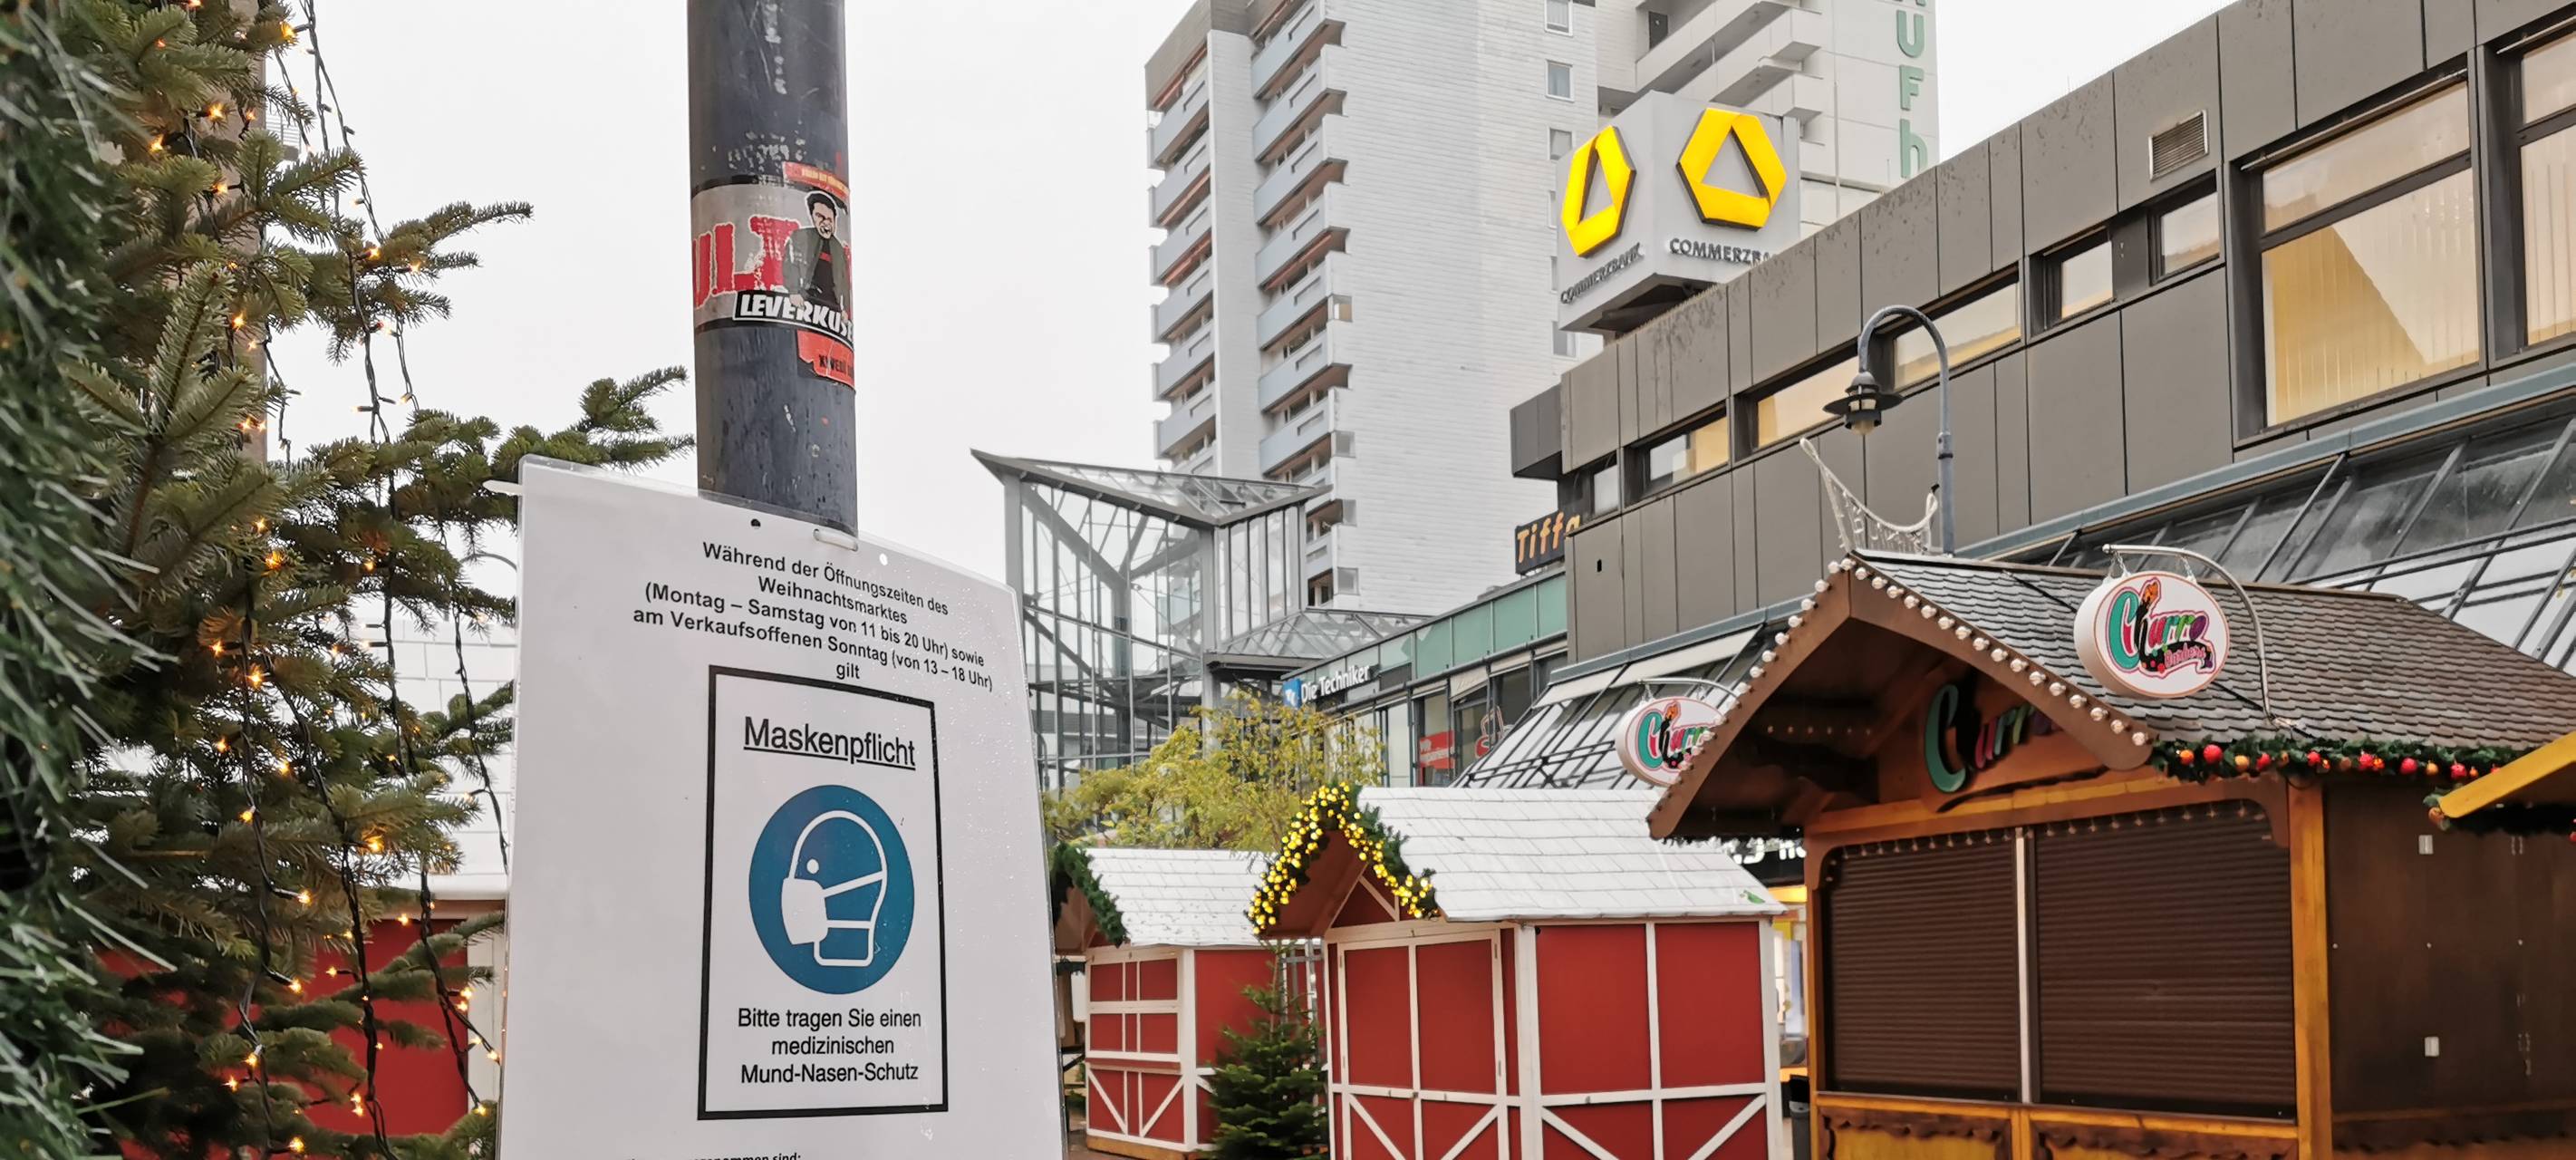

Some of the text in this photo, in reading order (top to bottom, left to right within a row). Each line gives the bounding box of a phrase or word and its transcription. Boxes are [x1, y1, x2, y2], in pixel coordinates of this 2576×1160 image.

[1896, 0, 1928, 179] UFh
[1560, 242, 1642, 304] COMMERZBANK
[703, 542, 949, 615] Während der Öffnungszeiten des
[758, 575, 908, 624] Weihnachtsmarktes
[645, 582, 725, 614] (Montag
[748, 599, 825, 629] Samstag
[829, 616, 857, 633] von
[861, 622, 875, 637] 11
[880, 626, 901, 644] bis
[904, 632, 919, 648] 20
[922, 636, 949, 660] Uhr)
[951, 647, 985, 666] sowie
[2108, 582, 2207, 672] Churro
[633, 609, 663, 625] am
[671, 610, 822, 649] Verkaufsoffenen
[827, 635, 888, 666] Sonntag
[892, 650, 920, 671] (von
[923, 659, 938, 674] 13
[951, 666, 966, 682] 18
[969, 671, 993, 692] Uhr)
[836, 662, 860, 680] gilt
[1301, 681, 1317, 703] Die
[1319, 664, 1370, 696] Techniker
[744, 716, 916, 768] Maskenpflicht
[738, 1008, 921, 1031] Bitte tragen Sie einen
[771, 1036, 894, 1055] medizinischen
[741, 1062, 919, 1083] Mund-Nasen-Schutz
